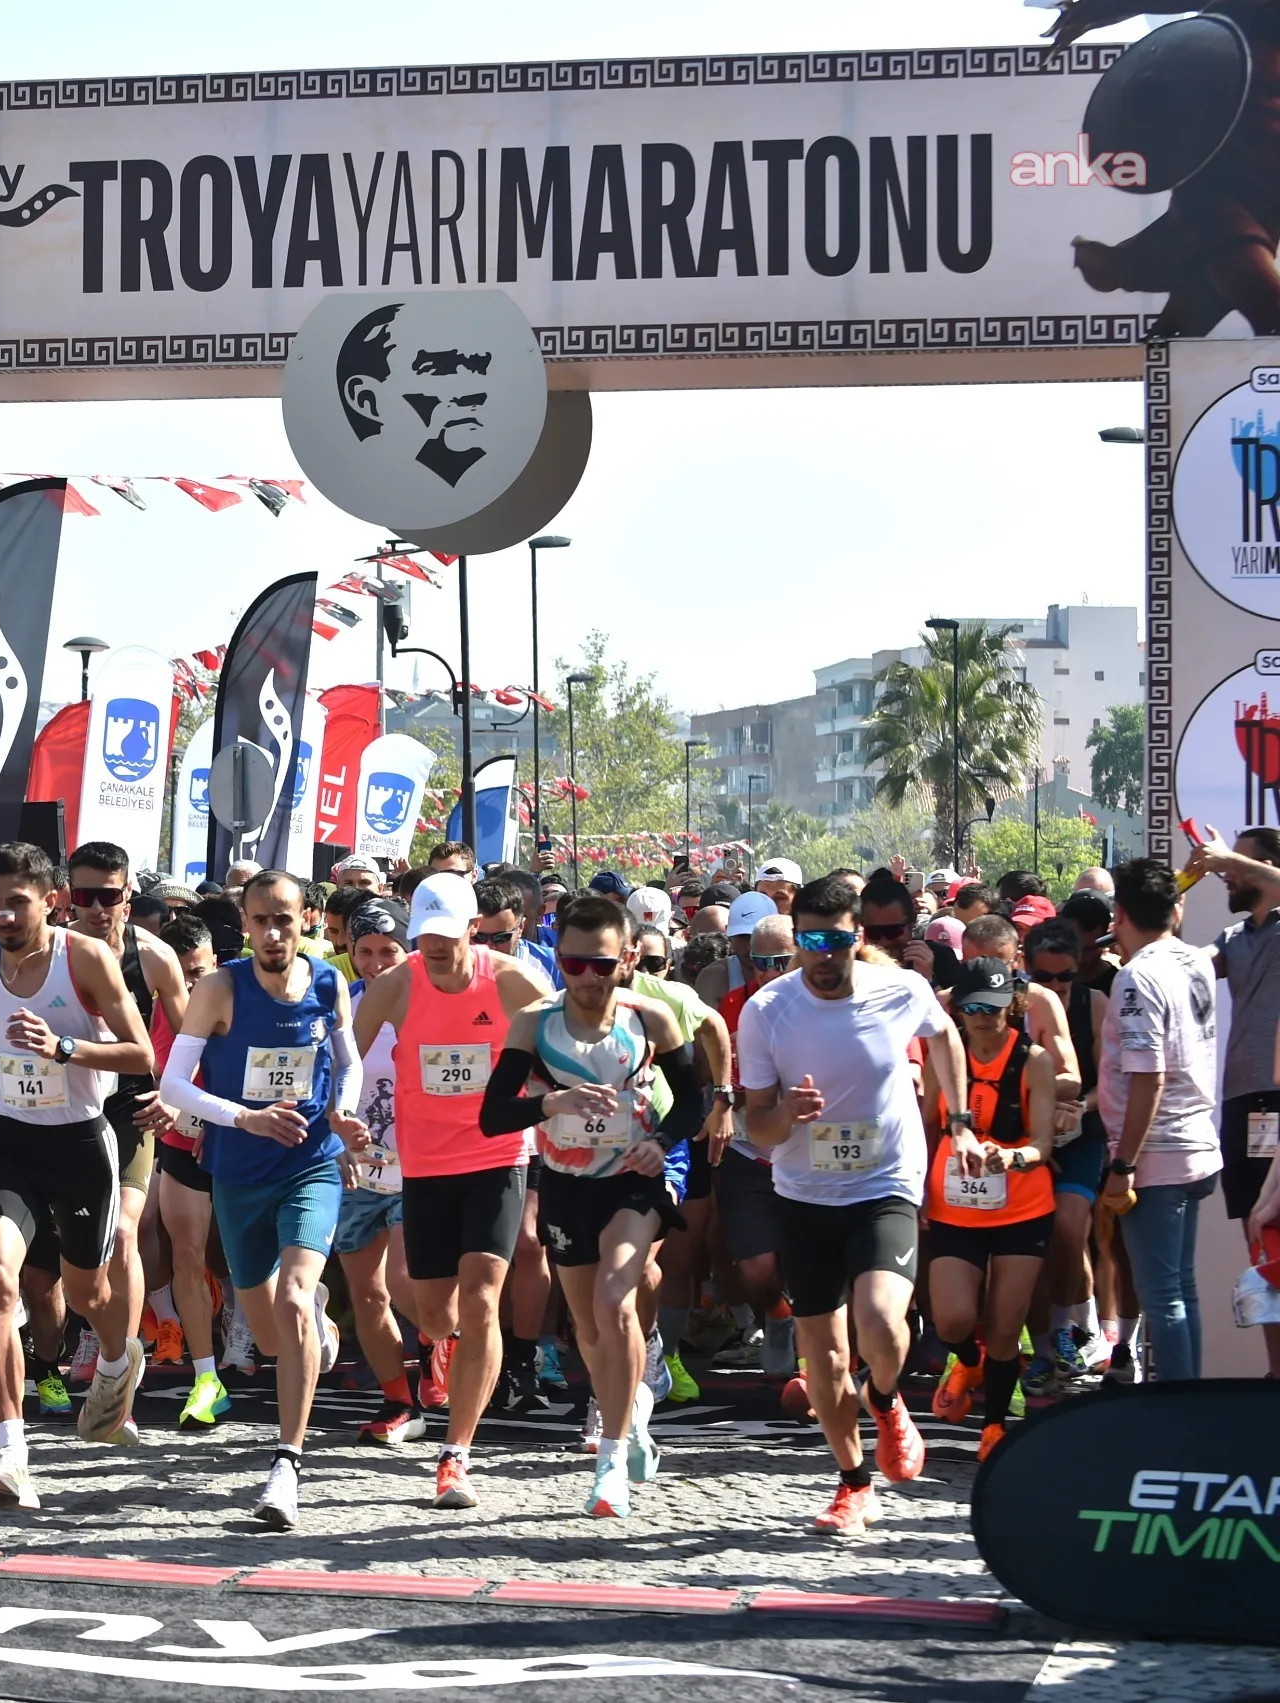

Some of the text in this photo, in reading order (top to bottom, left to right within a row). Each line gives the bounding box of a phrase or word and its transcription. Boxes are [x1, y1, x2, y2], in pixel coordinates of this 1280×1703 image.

[99, 781, 155, 798] ÇANAKKALE
[98, 792, 155, 811] BELEDİYESİ
[268, 1071, 294, 1086] 125
[441, 1068, 471, 1082] 290
[18, 1080, 43, 1095] 141
[584, 1118, 606, 1133] 66
[832, 1144, 861, 1159] 193
[368, 1165, 383, 1180] 71
[960, 1180, 988, 1195] 364
